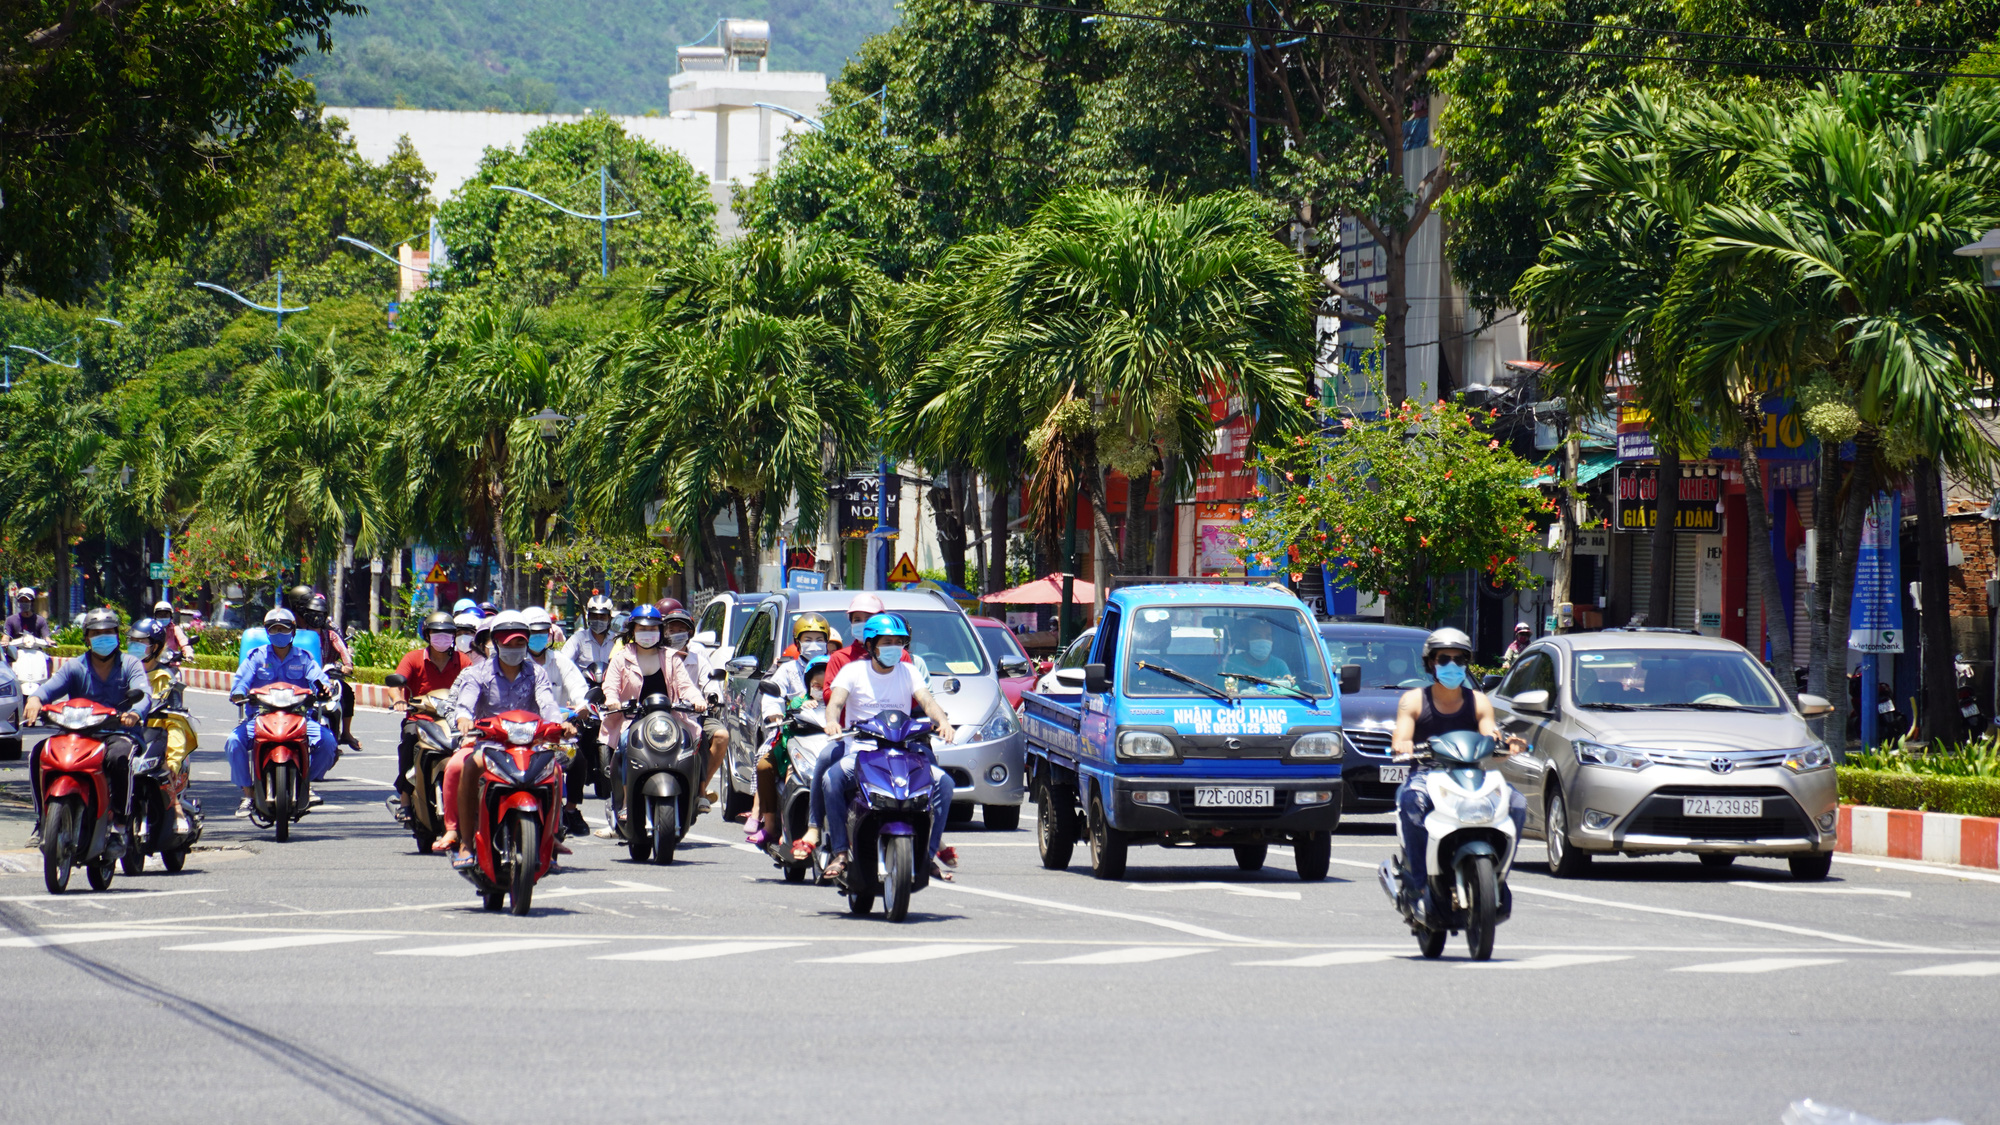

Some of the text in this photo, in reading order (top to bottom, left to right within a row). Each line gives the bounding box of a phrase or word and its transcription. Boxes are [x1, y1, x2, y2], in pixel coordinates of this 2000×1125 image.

[1679, 474, 1717, 500] NHIÊN
[870, 494, 896, 502] CU
[1623, 505, 1713, 527] GIÁ BH DÂN
[1249, 706, 1287, 724] HÀNG
[1213, 723, 1239, 734] 0933
[1241, 723, 1260, 734] 125
[1263, 723, 1282, 734] 365
[1198, 789, 1270, 806] 72C-008.51
[1686, 799, 1759, 815] 72A-239.85
